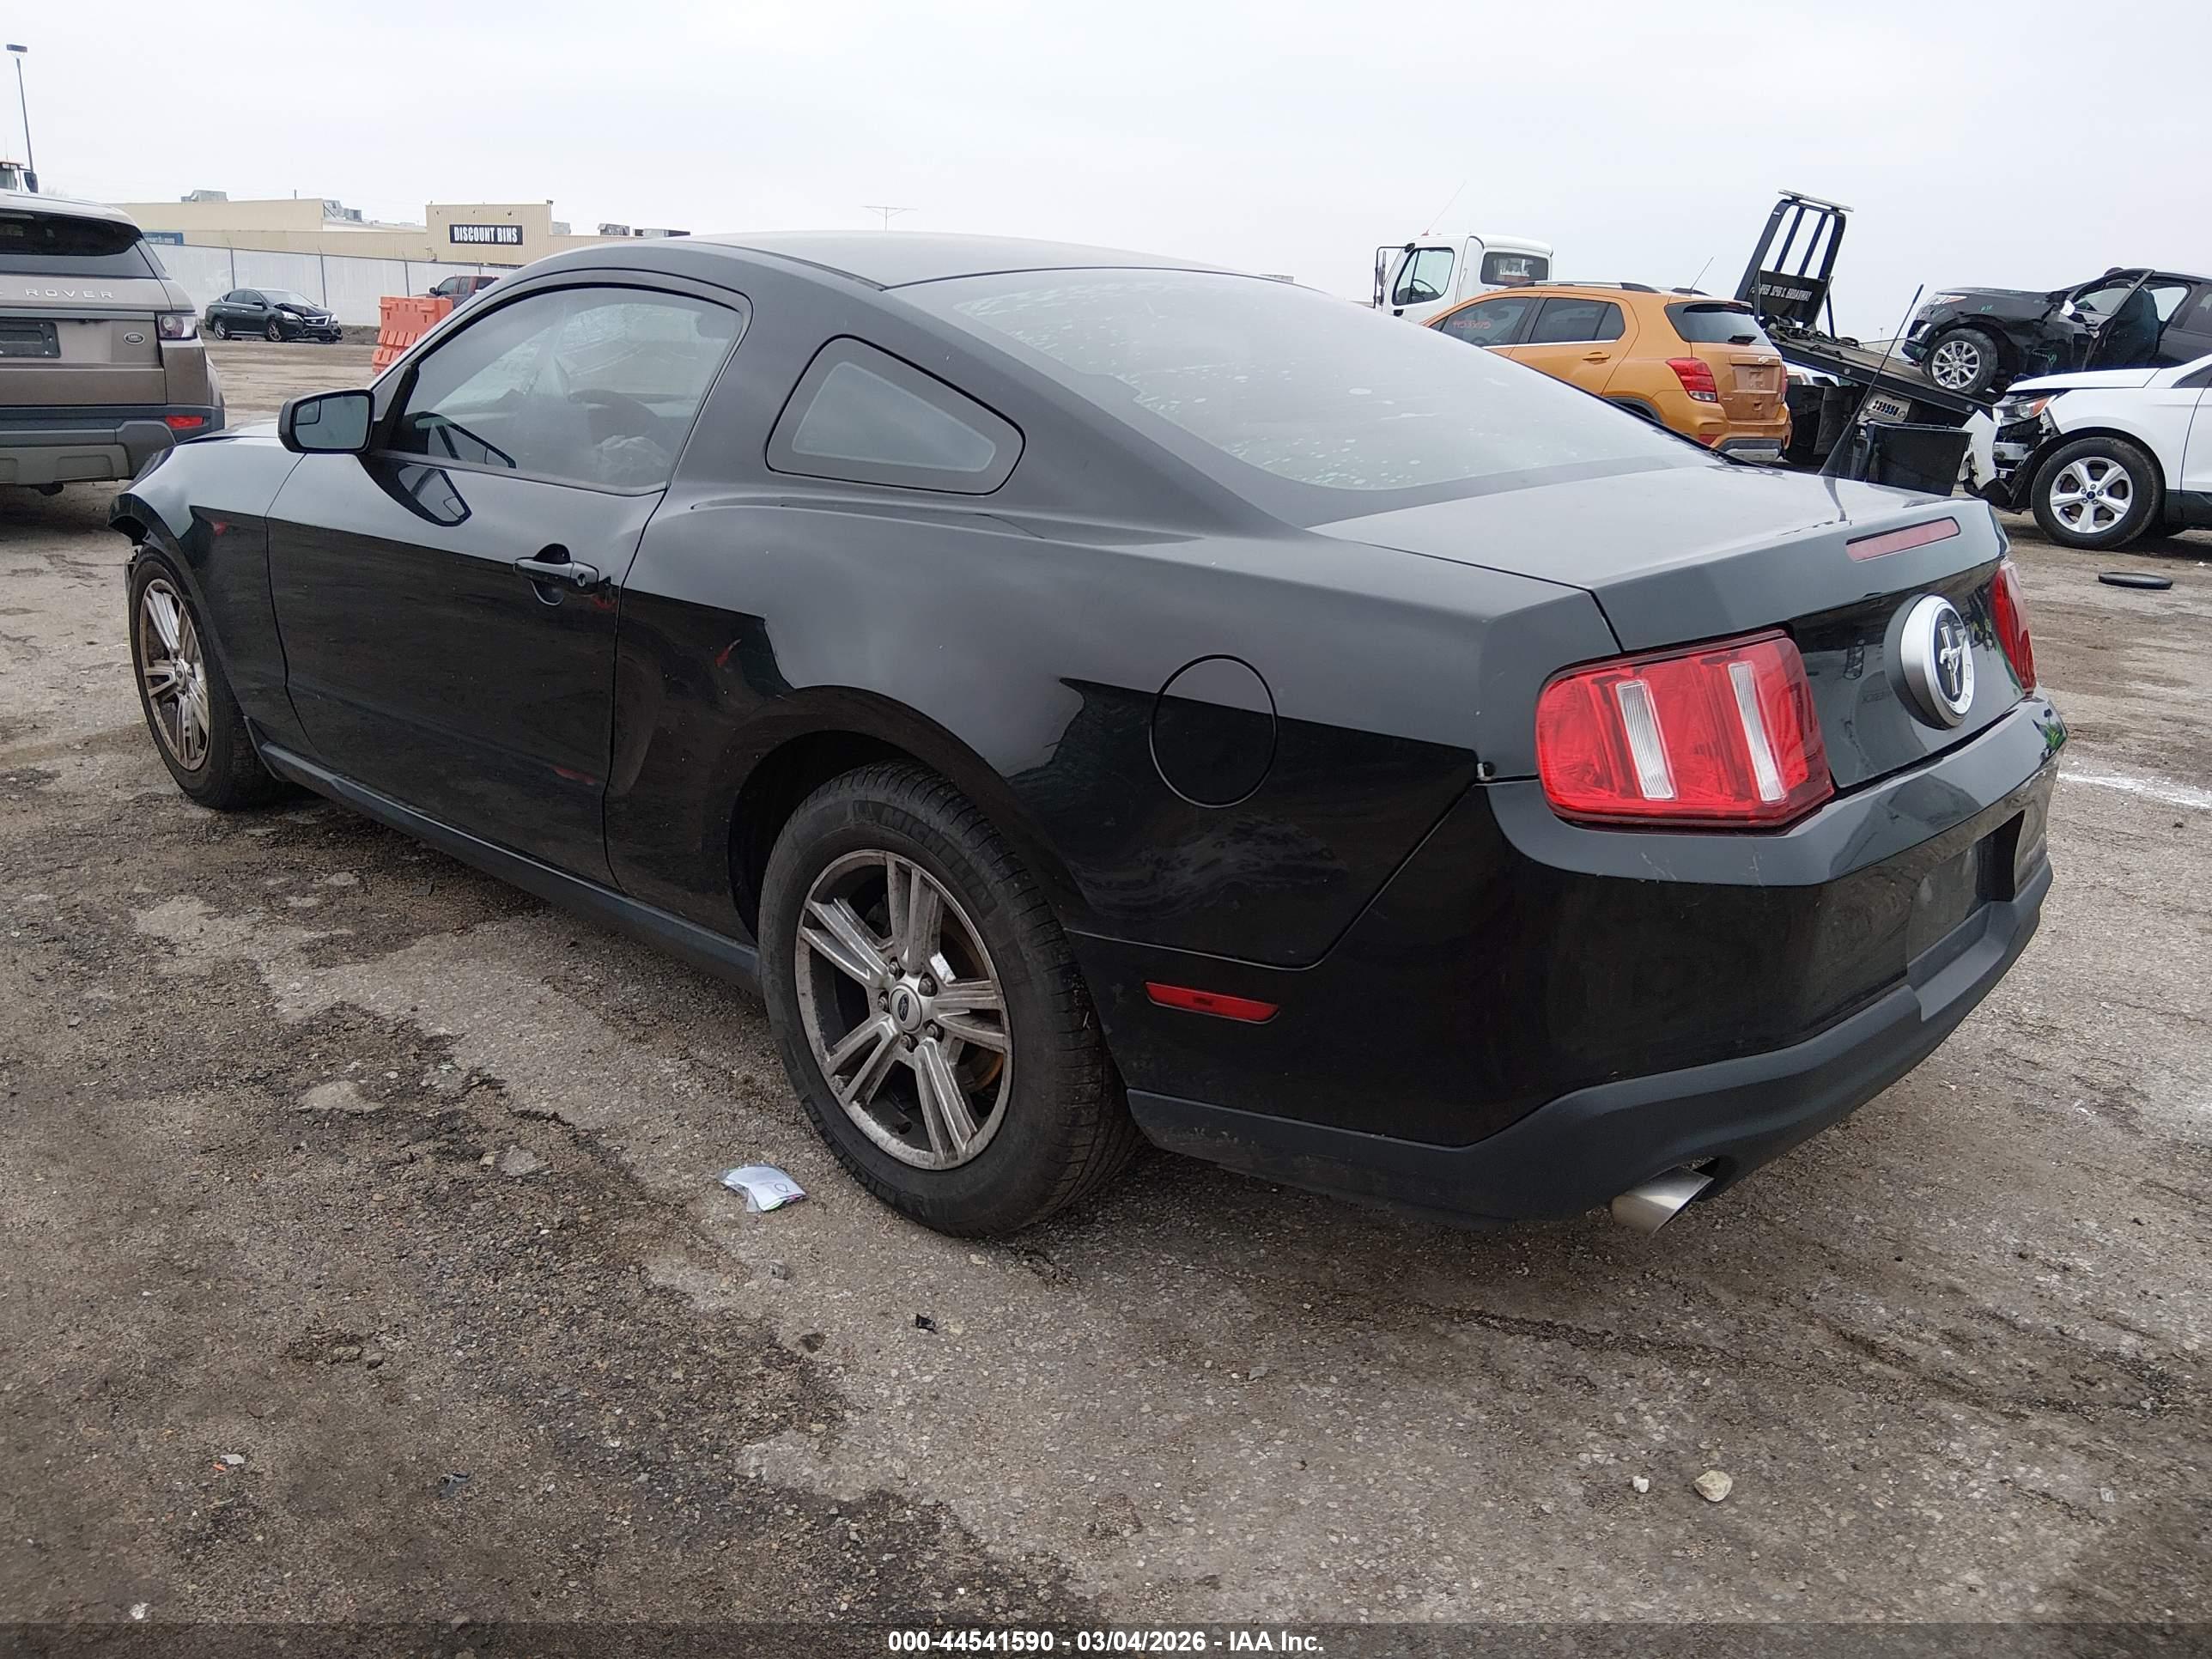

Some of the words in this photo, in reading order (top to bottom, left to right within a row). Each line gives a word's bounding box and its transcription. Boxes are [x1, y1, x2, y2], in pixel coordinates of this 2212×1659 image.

[453, 226, 495, 242] DISCOUNT
[496, 227, 518, 243] BINS
[25, 288, 114, 299] ROVER
